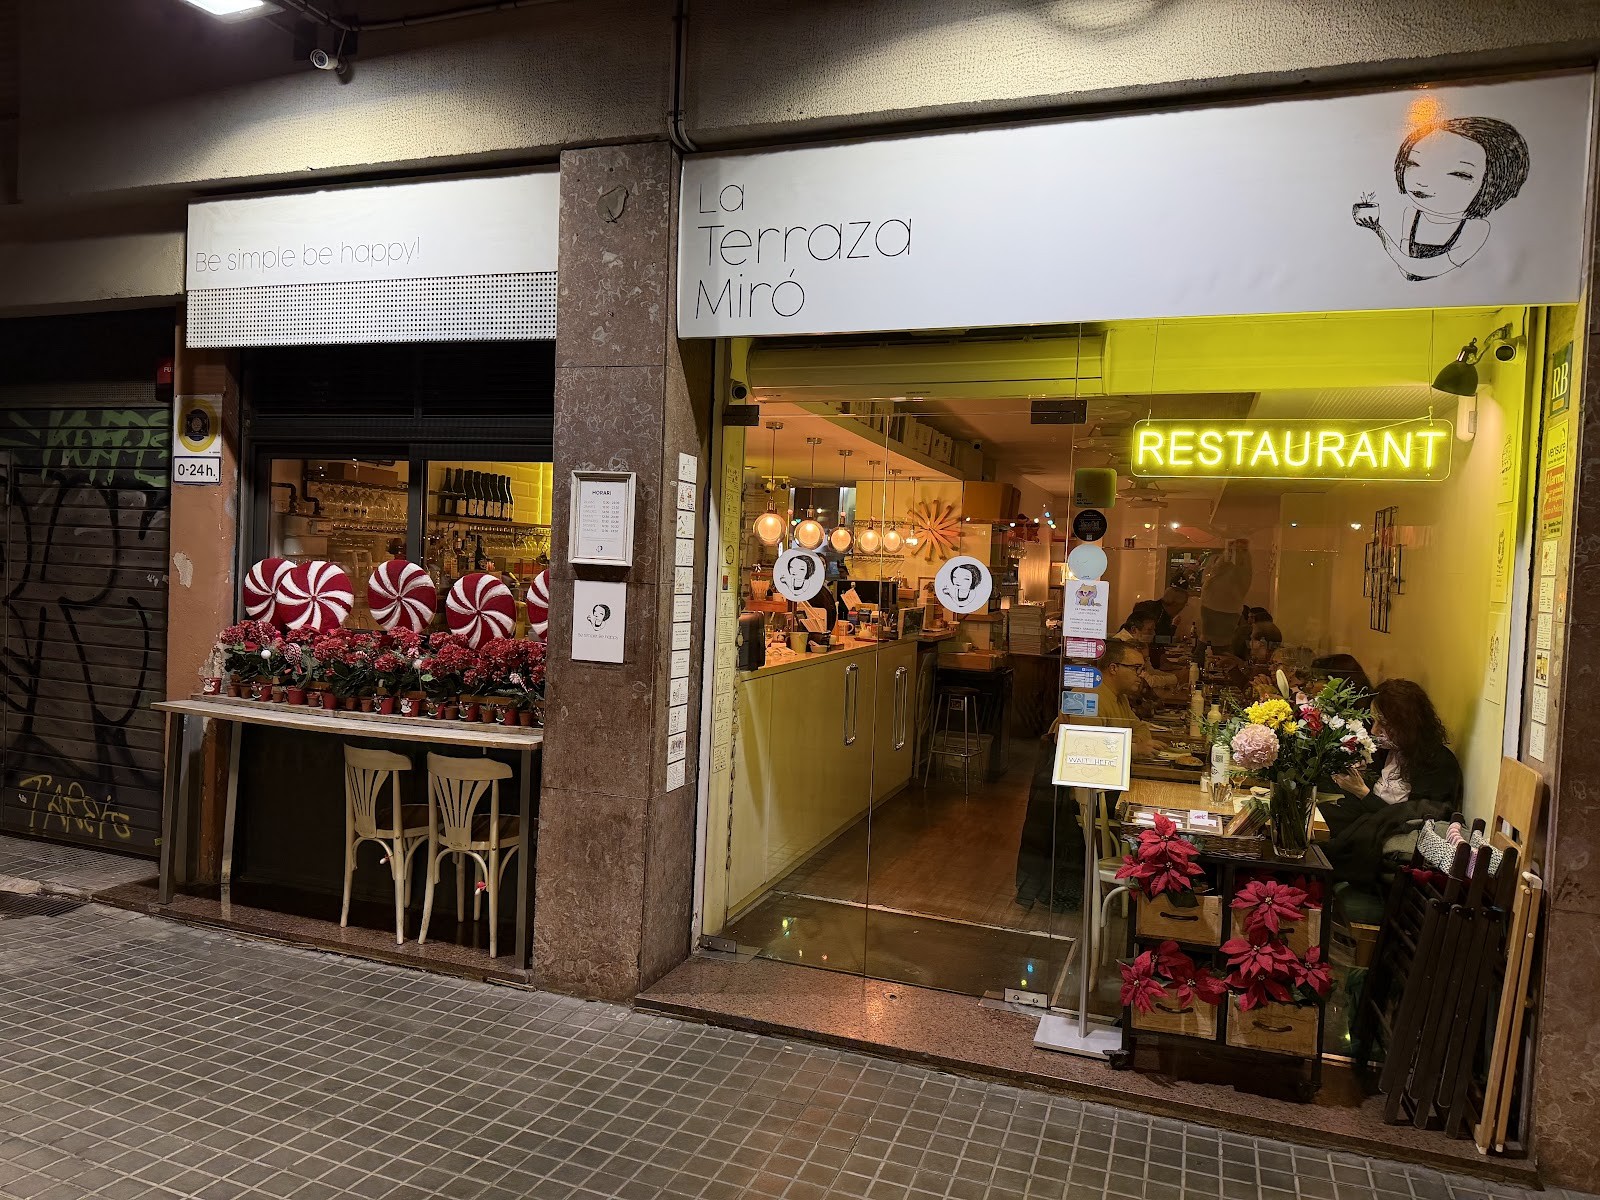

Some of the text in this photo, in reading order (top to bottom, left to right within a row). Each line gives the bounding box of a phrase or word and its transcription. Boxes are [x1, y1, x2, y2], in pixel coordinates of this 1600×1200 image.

[699, 183, 745, 214] La
[194, 236, 421, 274] Be simple be happy!
[697, 218, 912, 266] Terraza
[695, 268, 805, 320] Miró
[1551, 361, 1569, 400] RB
[1137, 430, 1447, 468] RESTAURANT
